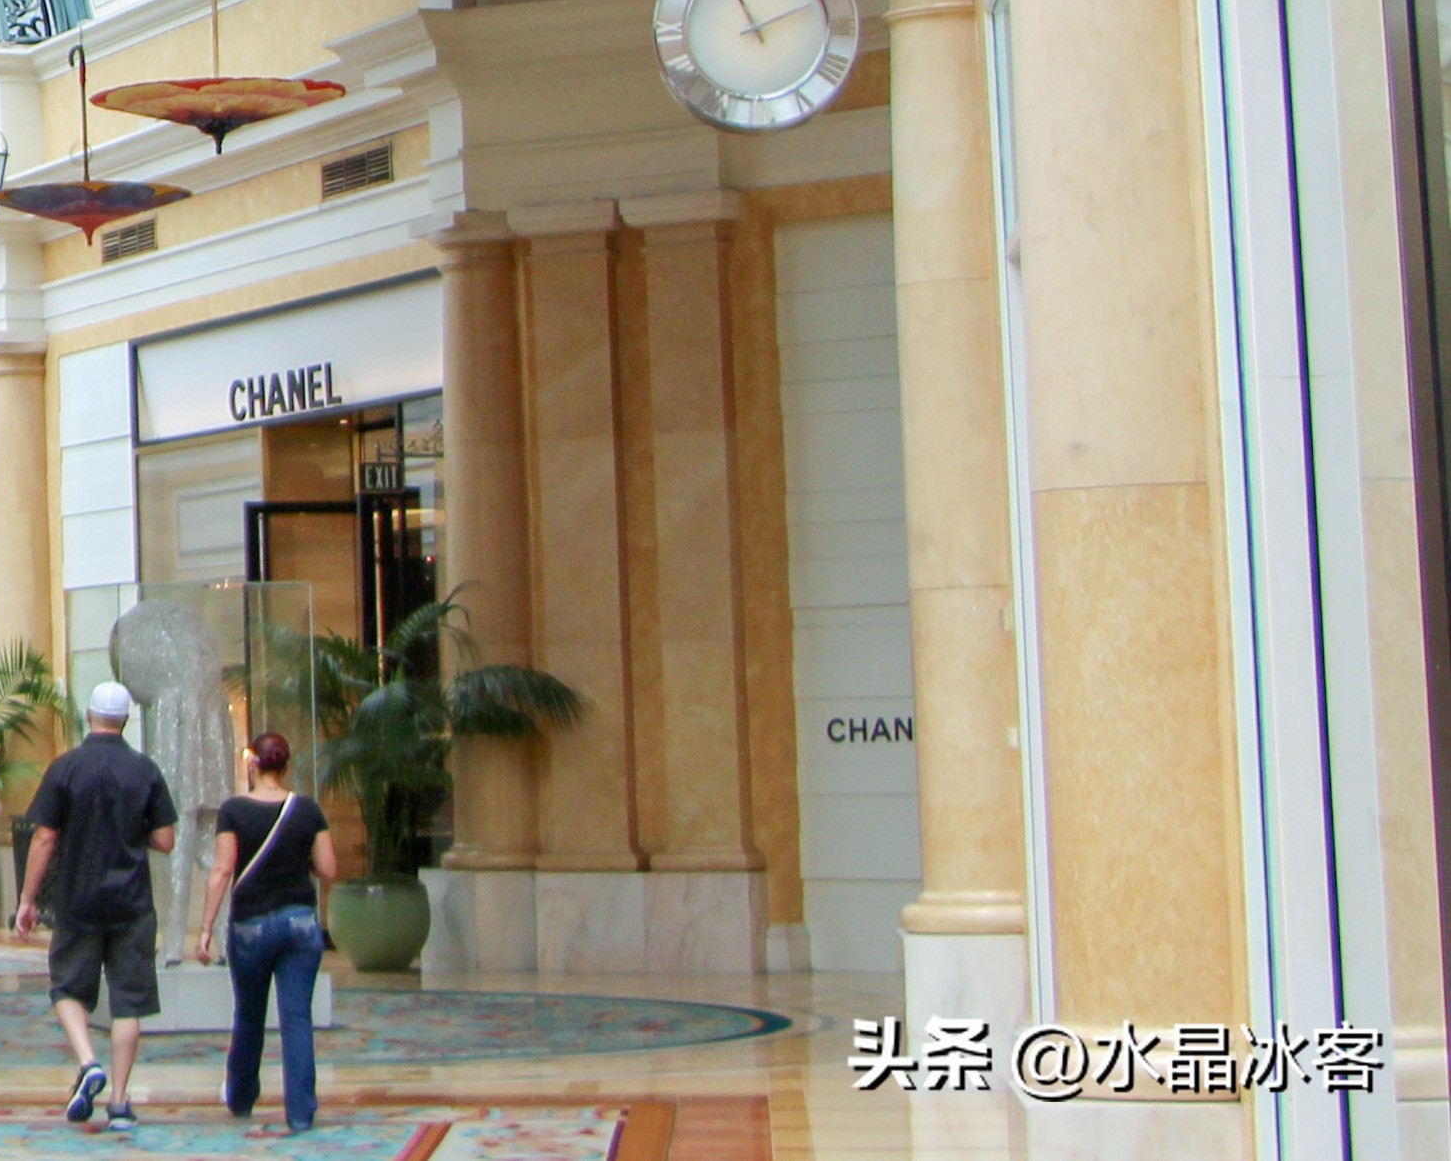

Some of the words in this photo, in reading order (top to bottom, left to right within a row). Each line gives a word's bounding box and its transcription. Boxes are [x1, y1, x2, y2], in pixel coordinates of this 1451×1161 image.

[229, 360, 342, 422] CHANEL
[365, 465, 397, 490] EXIT
[826, 716, 914, 743] CHAN
